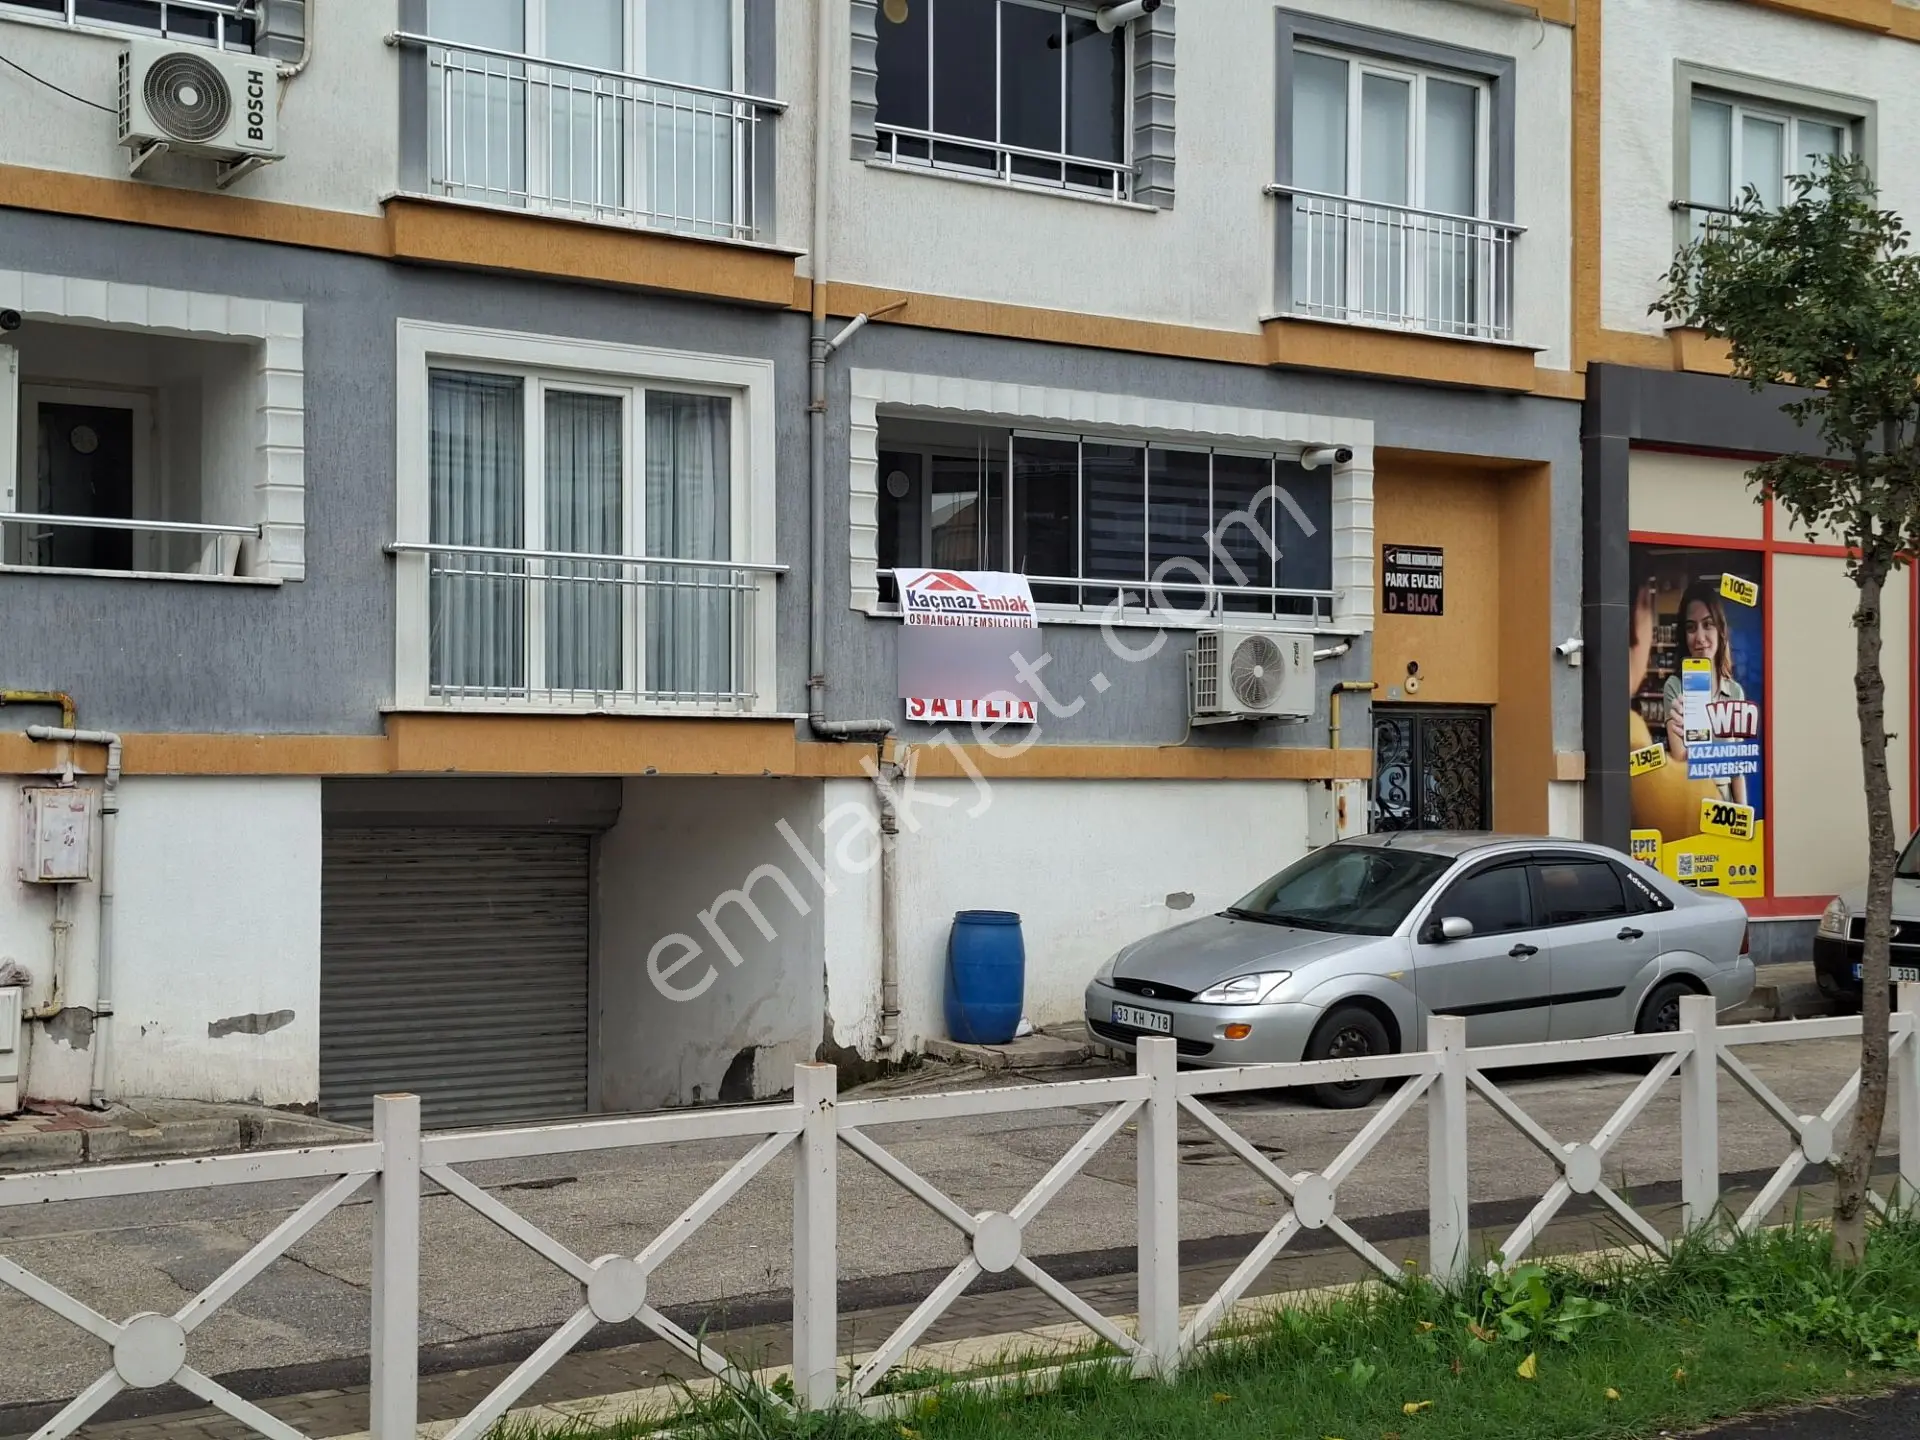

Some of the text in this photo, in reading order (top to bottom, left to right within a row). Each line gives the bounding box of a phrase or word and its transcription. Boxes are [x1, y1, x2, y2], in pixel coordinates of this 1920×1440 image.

[248, 70, 263, 141] BOSCH
[1385, 572, 1442, 589] PARK EVLERİ
[906, 589, 1030, 612] Kaçmaz Emlak
[1389, 592, 1397, 611] D
[1407, 592, 1438, 612] BLOK
[909, 613, 965, 627] OSMANGAZİ
[1688, 743, 1760, 759] KAZANDIRIR
[1631, 838, 1657, 853] EPTE
[1117, 1007, 1168, 1030] 33 KH 718
